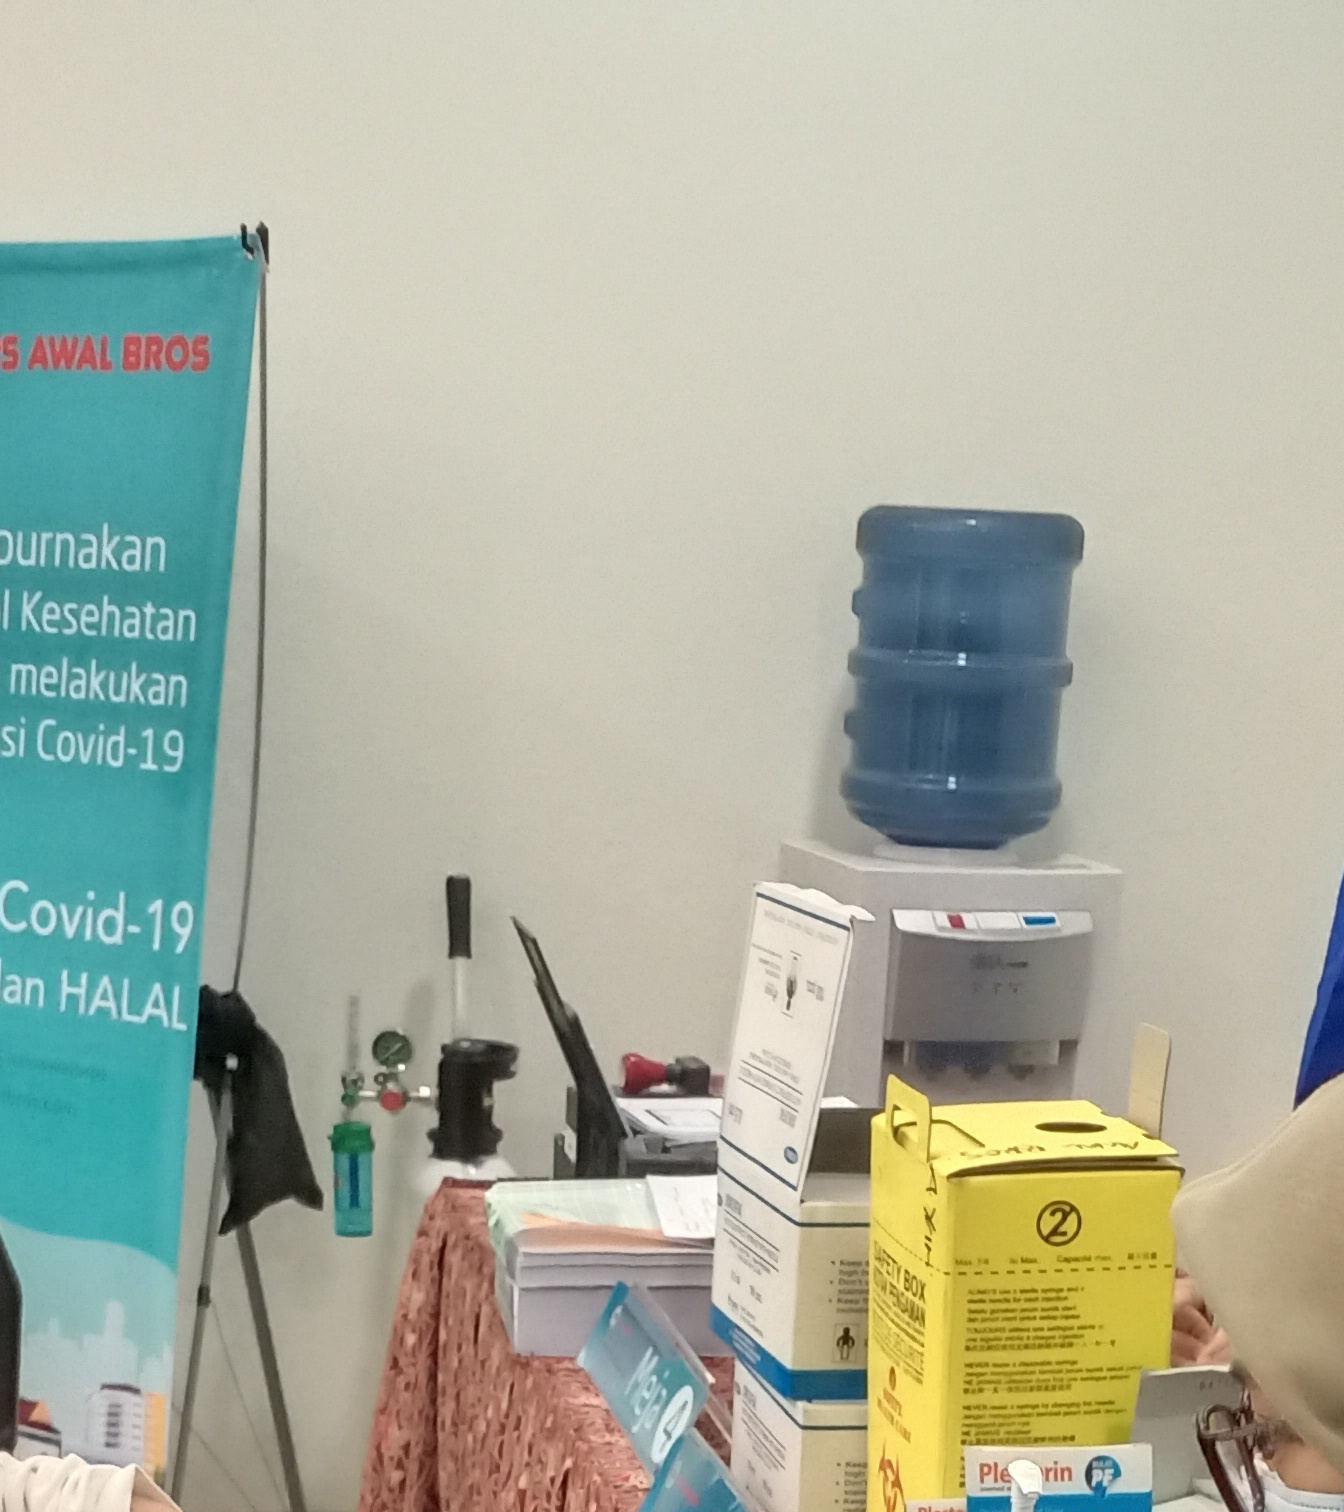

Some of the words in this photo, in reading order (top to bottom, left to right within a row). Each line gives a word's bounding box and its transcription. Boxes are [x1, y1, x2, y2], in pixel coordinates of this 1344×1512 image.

[27, 335, 112, 372] AWAL
[122, 335, 210, 372] BROS
[21, 591, 196, 642] Kesehatan
[10, 656, 188, 708] melakukan
[37, 719, 184, 773] Covid-19
[60, 969, 188, 1031] HALAL
[903, 1268, 927, 1304] BOX
[978, 1460, 1073, 1484] Plerin
